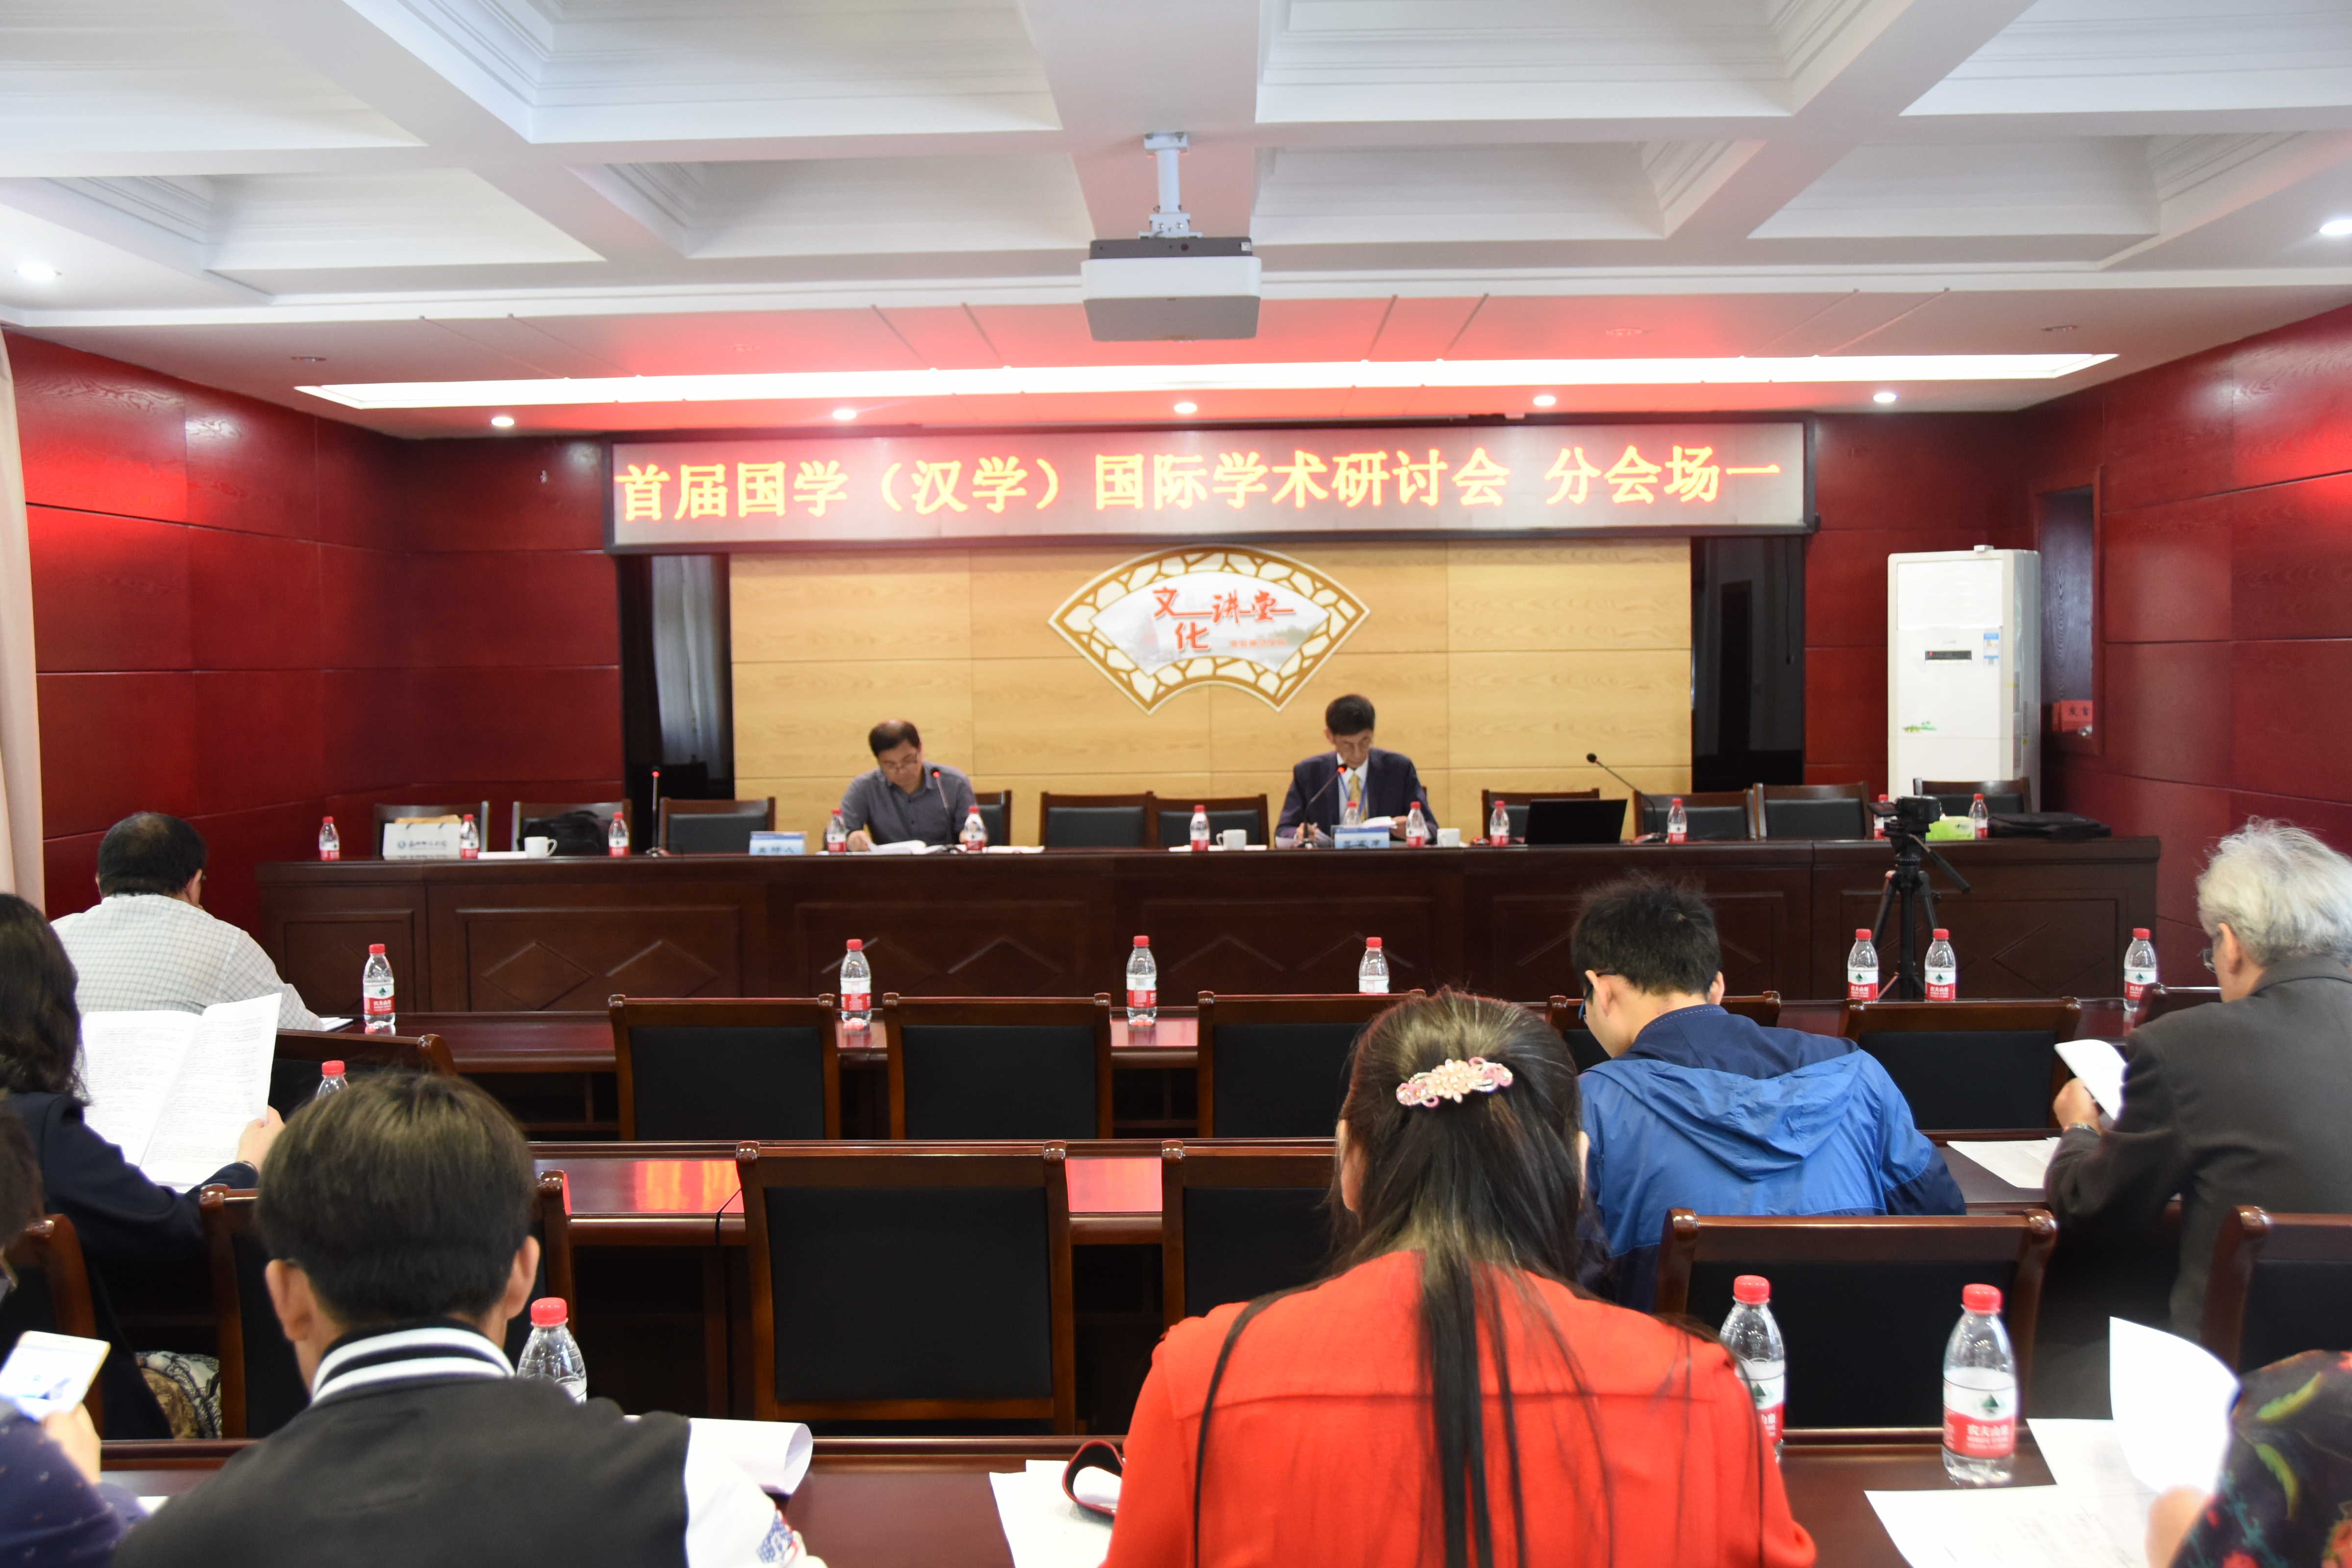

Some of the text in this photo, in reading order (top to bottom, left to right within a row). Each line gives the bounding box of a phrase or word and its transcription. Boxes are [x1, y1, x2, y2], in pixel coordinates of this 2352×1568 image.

[614, 445, 1781, 521] 首届国学（汉学）国际学术研讨会 分会场一
